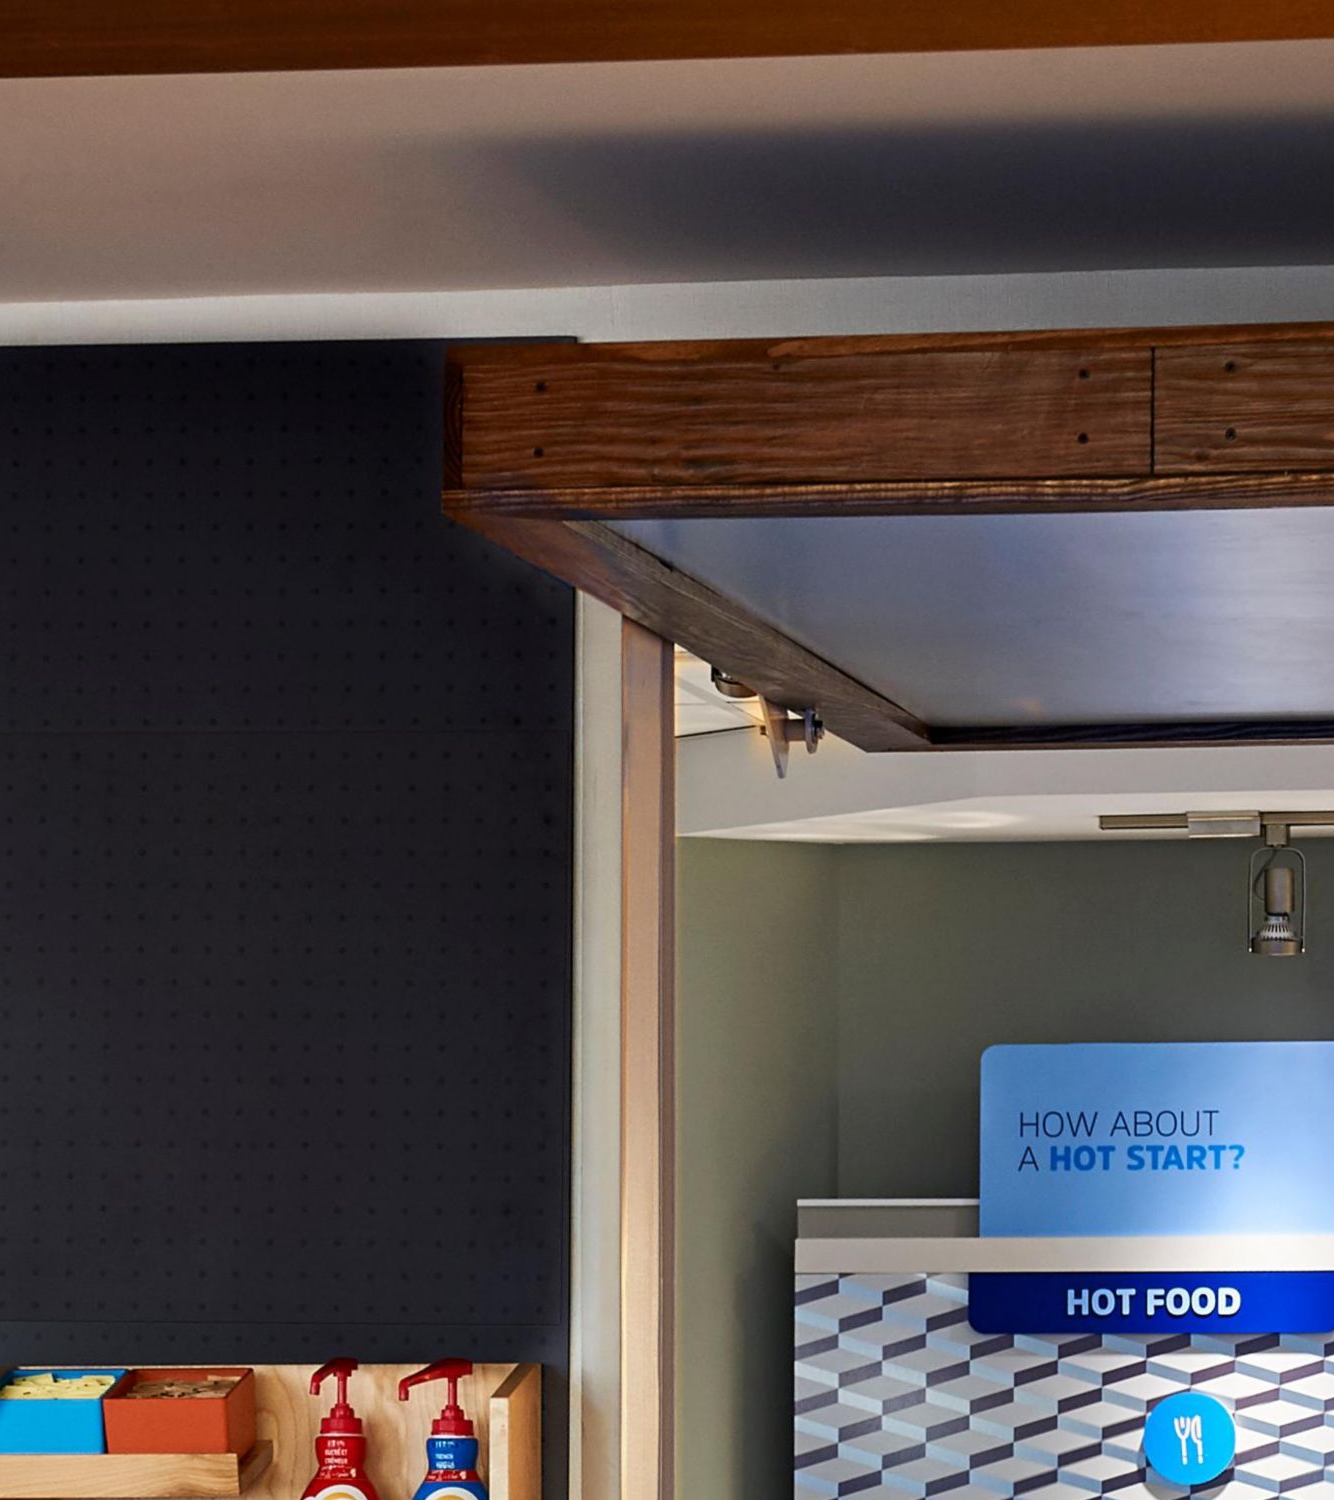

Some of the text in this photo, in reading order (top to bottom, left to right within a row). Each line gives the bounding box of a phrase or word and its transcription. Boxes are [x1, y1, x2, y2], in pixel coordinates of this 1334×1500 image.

[1019, 1109, 1220, 1138] HOW ABOUT
[1018, 1144, 1245, 1172] A HOT START?
[1067, 1287, 1241, 1316] HOT FOOD
